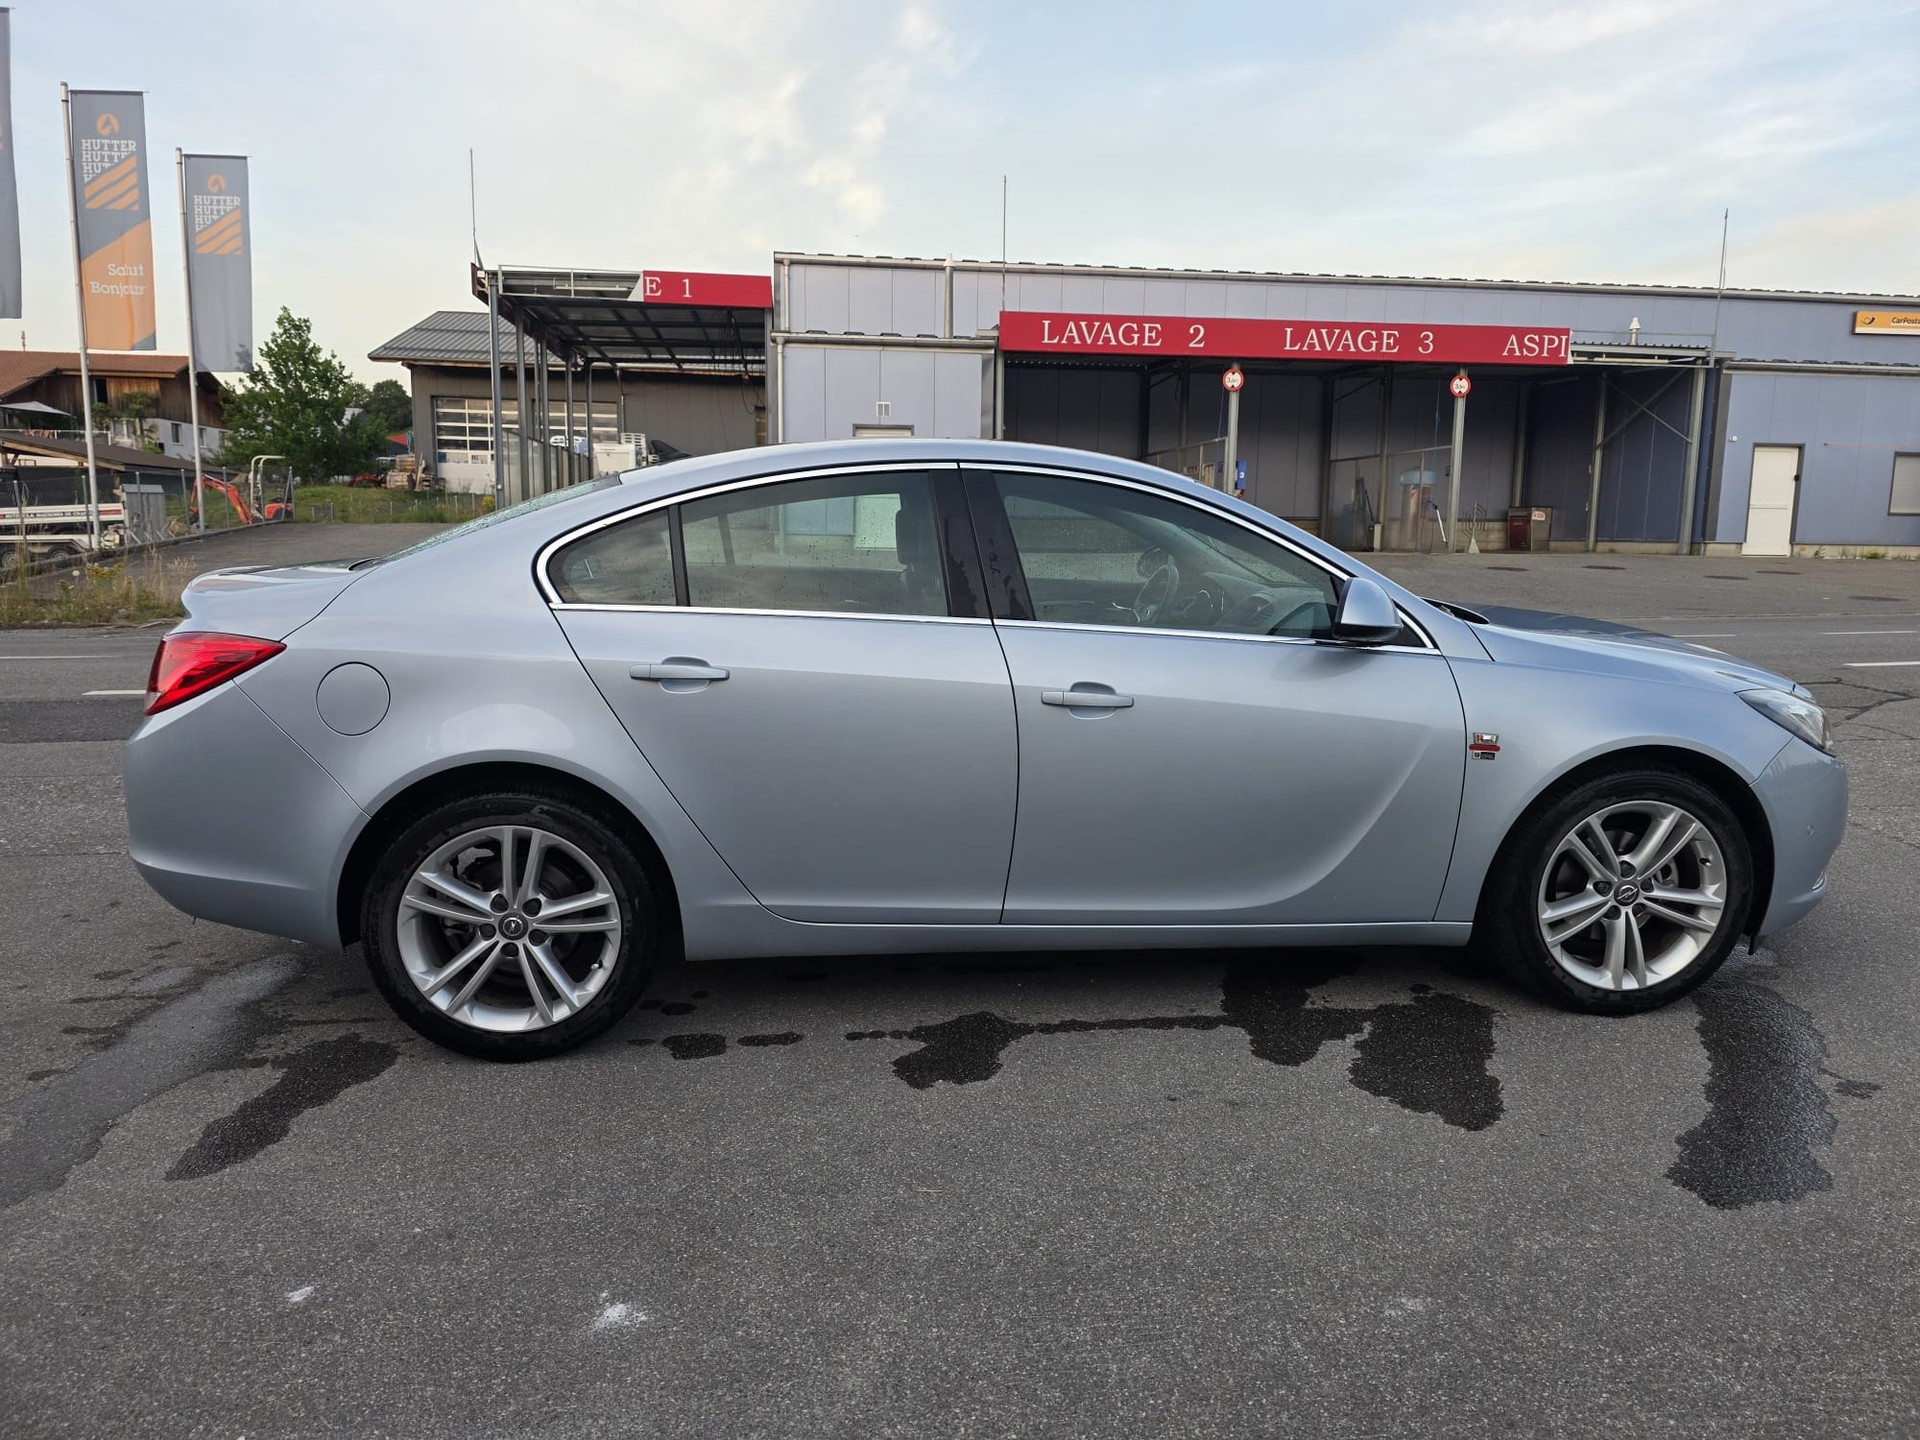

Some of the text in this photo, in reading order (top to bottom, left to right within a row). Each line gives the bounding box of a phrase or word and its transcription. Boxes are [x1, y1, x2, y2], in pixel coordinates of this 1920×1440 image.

[81, 138, 137, 152] HUTTER
[193, 194, 241, 206] HUTTER
[107, 263, 145, 277] Salut
[89, 281, 146, 297] Bonjour
[682, 278, 692, 298] 1
[1041, 319, 1206, 348] LAVAGE 2
[1283, 327, 1434, 354] LAVAGE 3
[1502, 334, 1568, 358] ASPI
